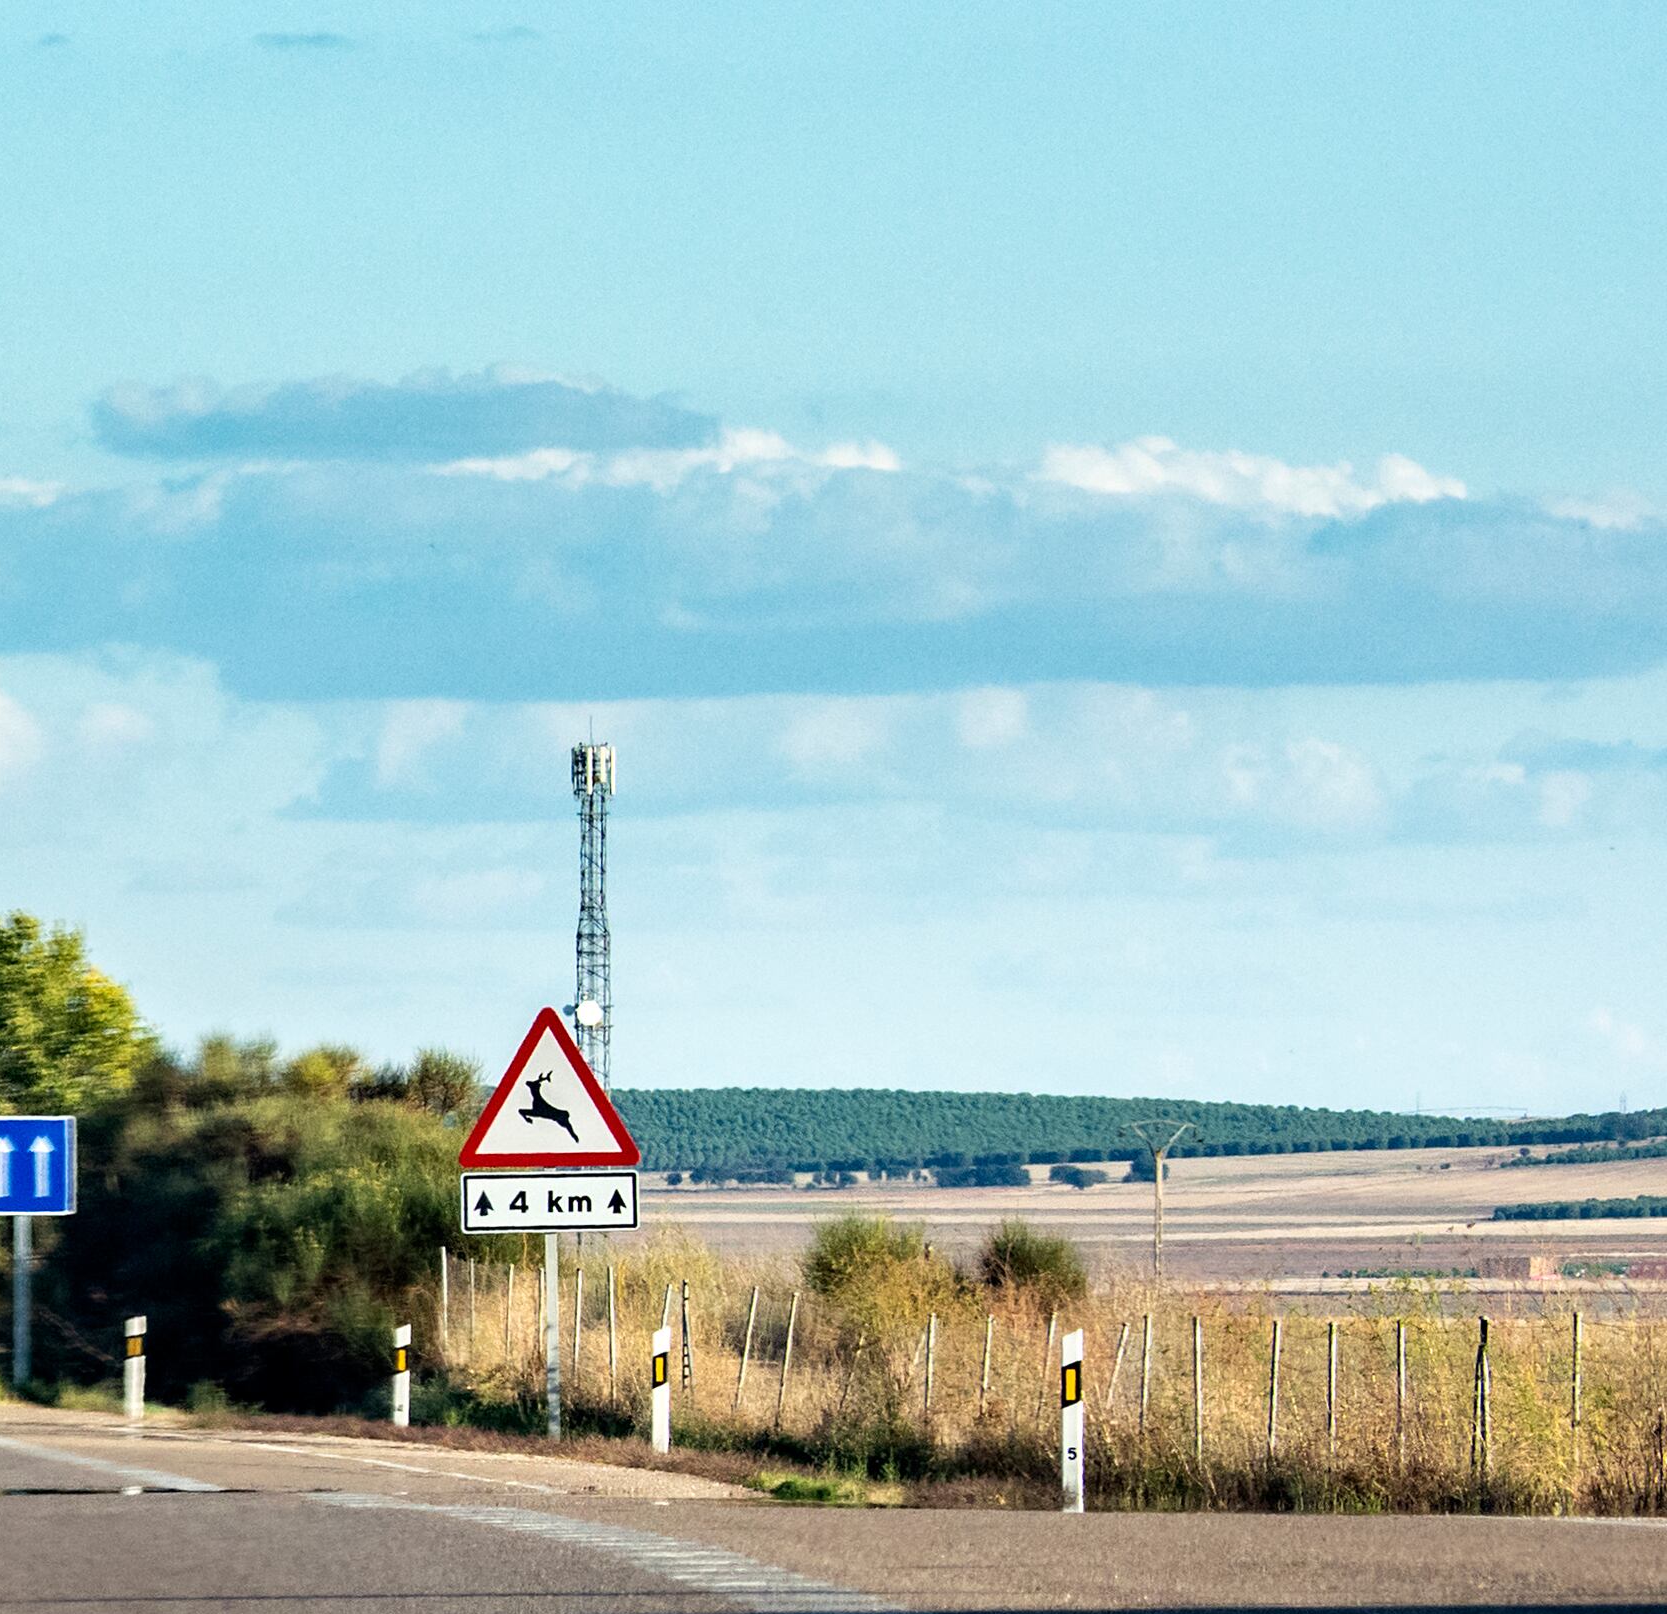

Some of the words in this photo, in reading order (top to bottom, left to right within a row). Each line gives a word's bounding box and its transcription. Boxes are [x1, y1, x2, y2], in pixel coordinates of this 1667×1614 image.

[509, 1190, 529, 1214] 4
[547, 1190, 592, 1213] km
[1067, 1447, 1077, 1460] 5
